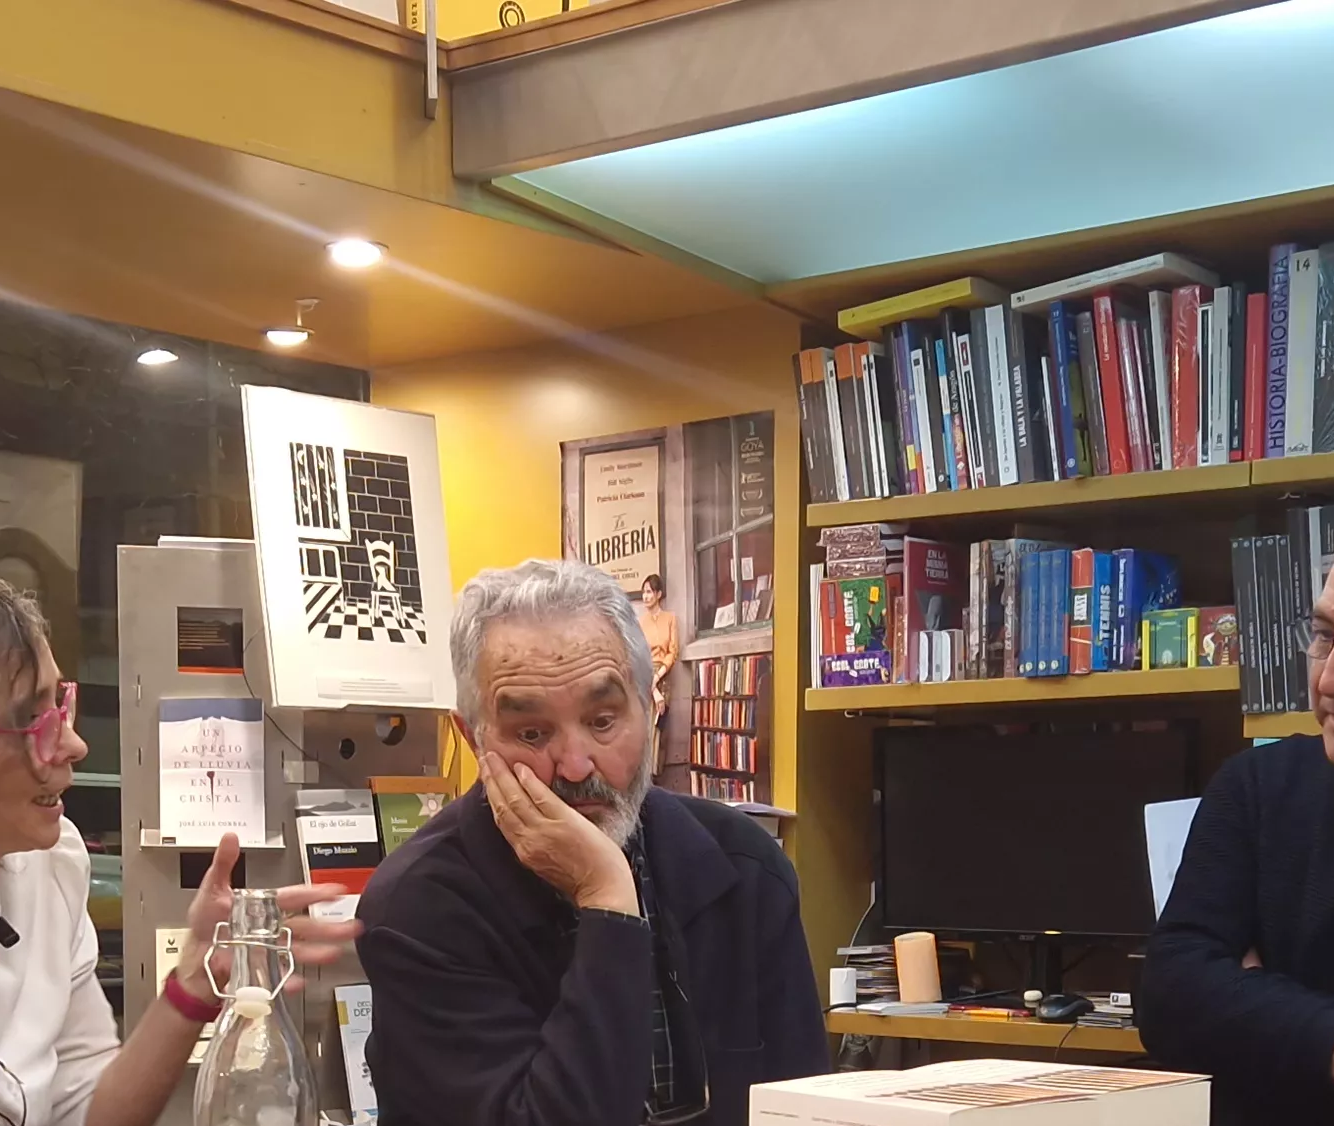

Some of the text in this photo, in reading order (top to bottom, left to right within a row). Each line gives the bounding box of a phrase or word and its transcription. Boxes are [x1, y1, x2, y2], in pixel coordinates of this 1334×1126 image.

[1296, 259, 1310, 271] 14
[587, 520, 656, 566] LIBRERÍA
[203, 728, 220, 738] UN
[181, 745, 242, 754] ARPEGIO
[174, 761, 251, 770] DE LLUVIA
[191, 779, 233, 787] EN EL
[179, 794, 241, 803] CRISTAL
[310, 820, 317, 828] El
[329, 820, 337, 828] de
[313, 847, 333, 856] Diego
